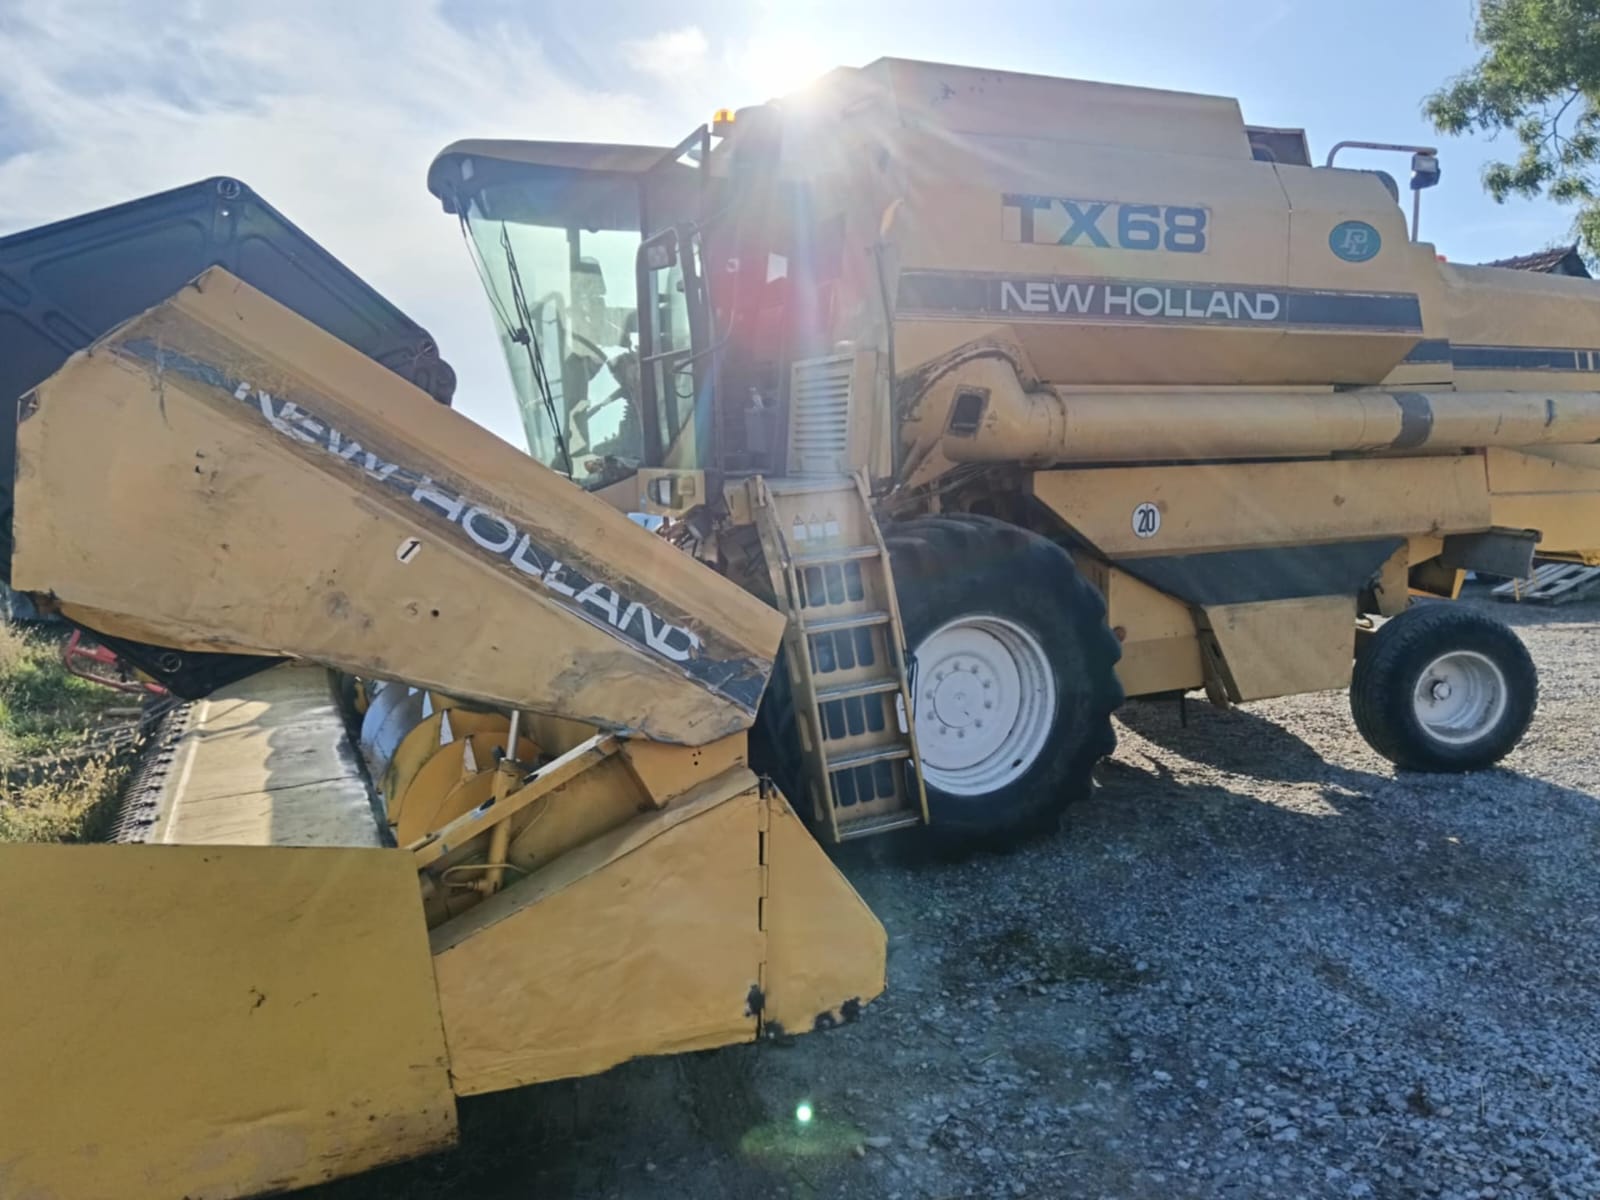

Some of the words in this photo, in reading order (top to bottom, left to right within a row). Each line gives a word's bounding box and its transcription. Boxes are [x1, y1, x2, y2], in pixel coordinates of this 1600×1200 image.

[1001, 193, 1207, 253] TX68
[1000, 280, 1095, 314] NEW
[1103, 286, 1280, 321] HOLLAND
[234, 381, 399, 481] NEW
[410, 474, 702, 662] HOLLAND
[1138, 508, 1156, 533] 20
[400, 540, 420, 560] 1
